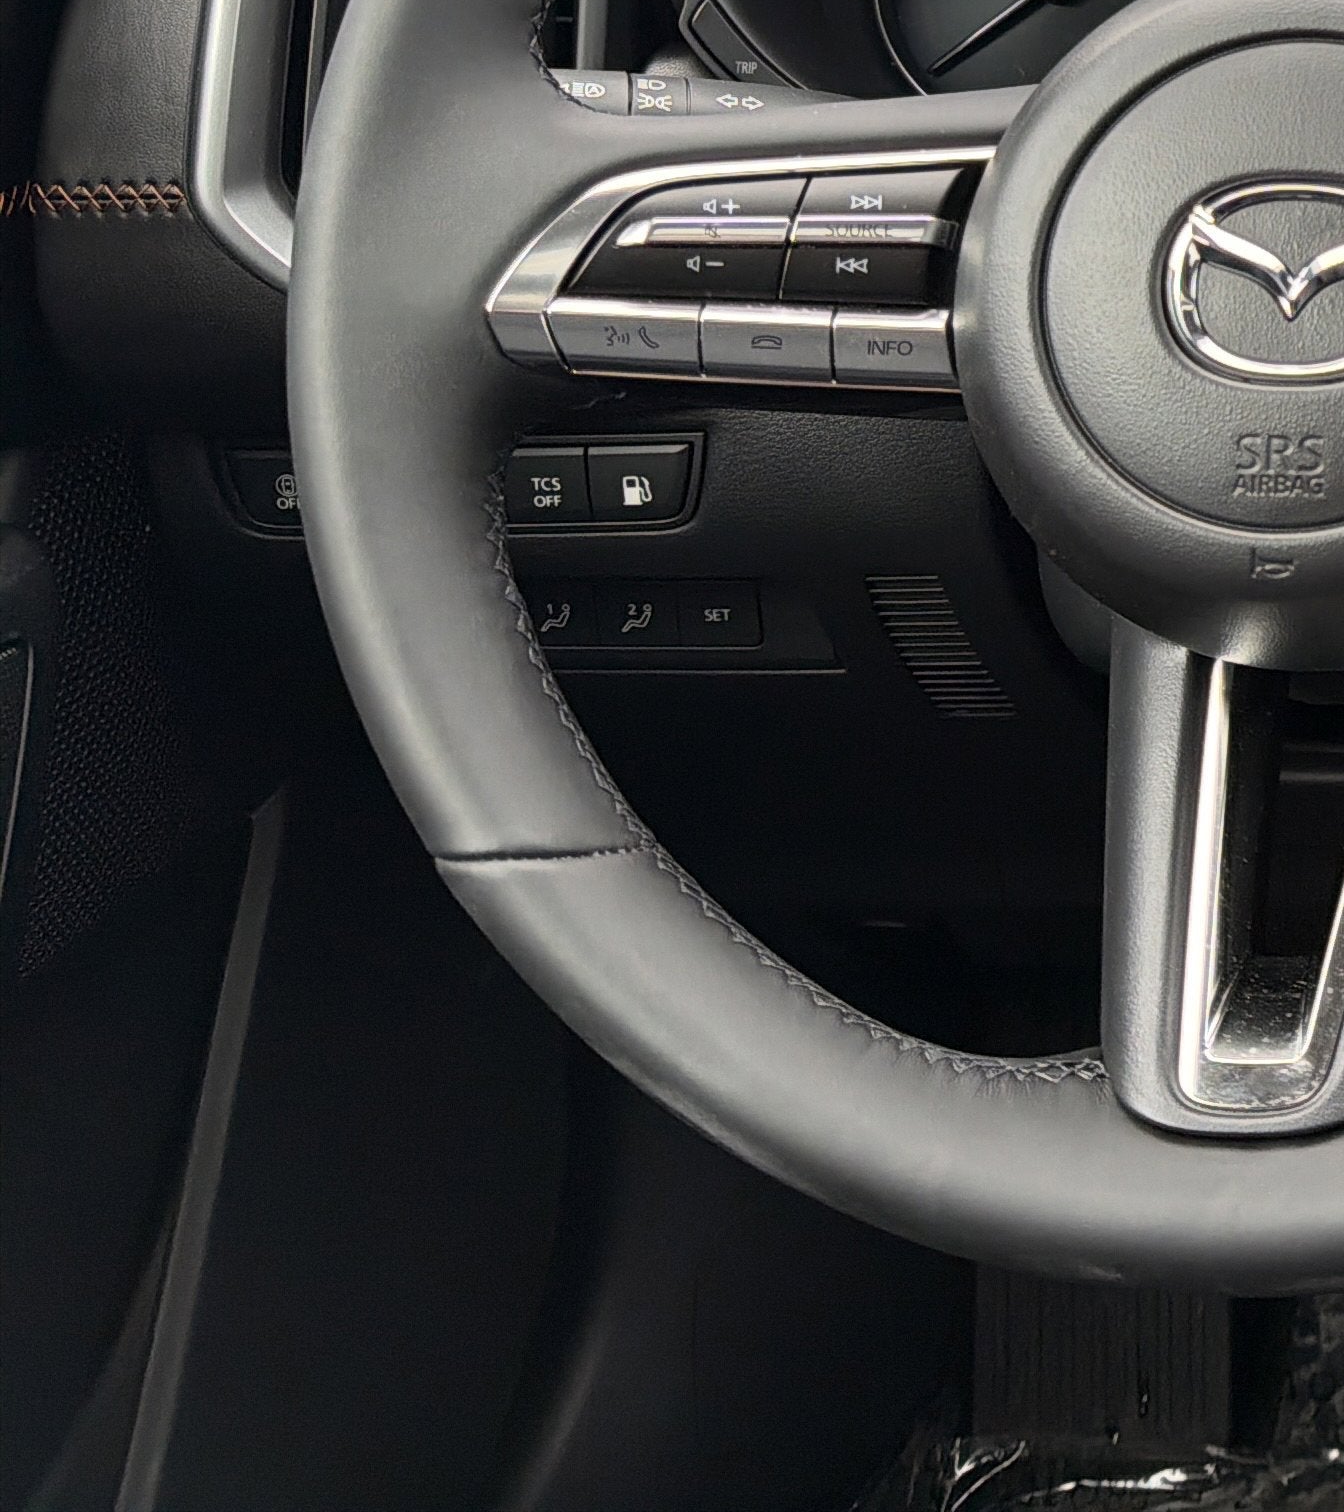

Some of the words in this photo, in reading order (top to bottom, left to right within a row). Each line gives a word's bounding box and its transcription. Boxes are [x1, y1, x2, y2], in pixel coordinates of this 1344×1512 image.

[735, 61, 758, 75] TRIP
[825, 223, 894, 238] SOURCE
[866, 339, 914, 357] INFO
[1235, 433, 1326, 473] SRS
[530, 475, 562, 492] TCS
[1232, 473, 1328, 498] AIRBAG
[533, 493, 563, 508] OFF
[627, 602, 637, 616] 2
[703, 608, 732, 622] SET
